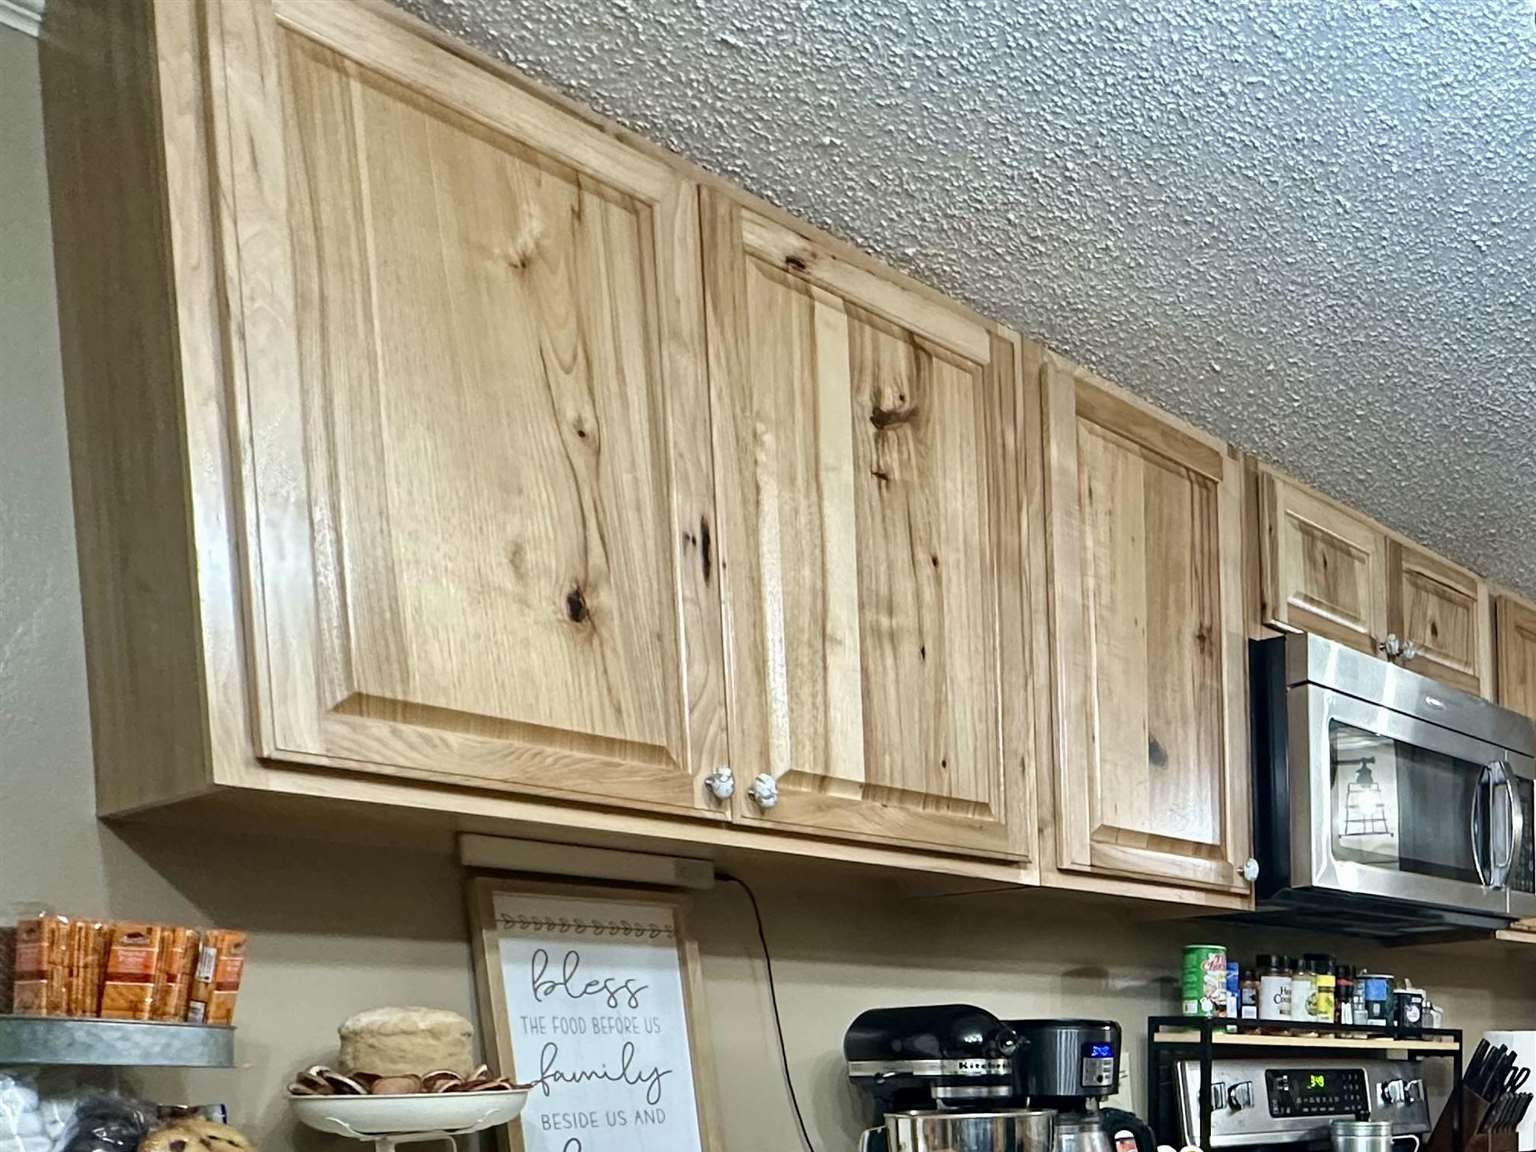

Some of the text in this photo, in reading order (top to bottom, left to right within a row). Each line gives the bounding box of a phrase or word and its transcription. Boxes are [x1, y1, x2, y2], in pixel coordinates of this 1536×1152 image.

[532, 948, 648, 1009] bless
[520, 1015, 661, 1035] THE FOOD BEFORE US
[531, 1041, 673, 1105] family
[541, 1108, 666, 1131] BESIDE US AND
